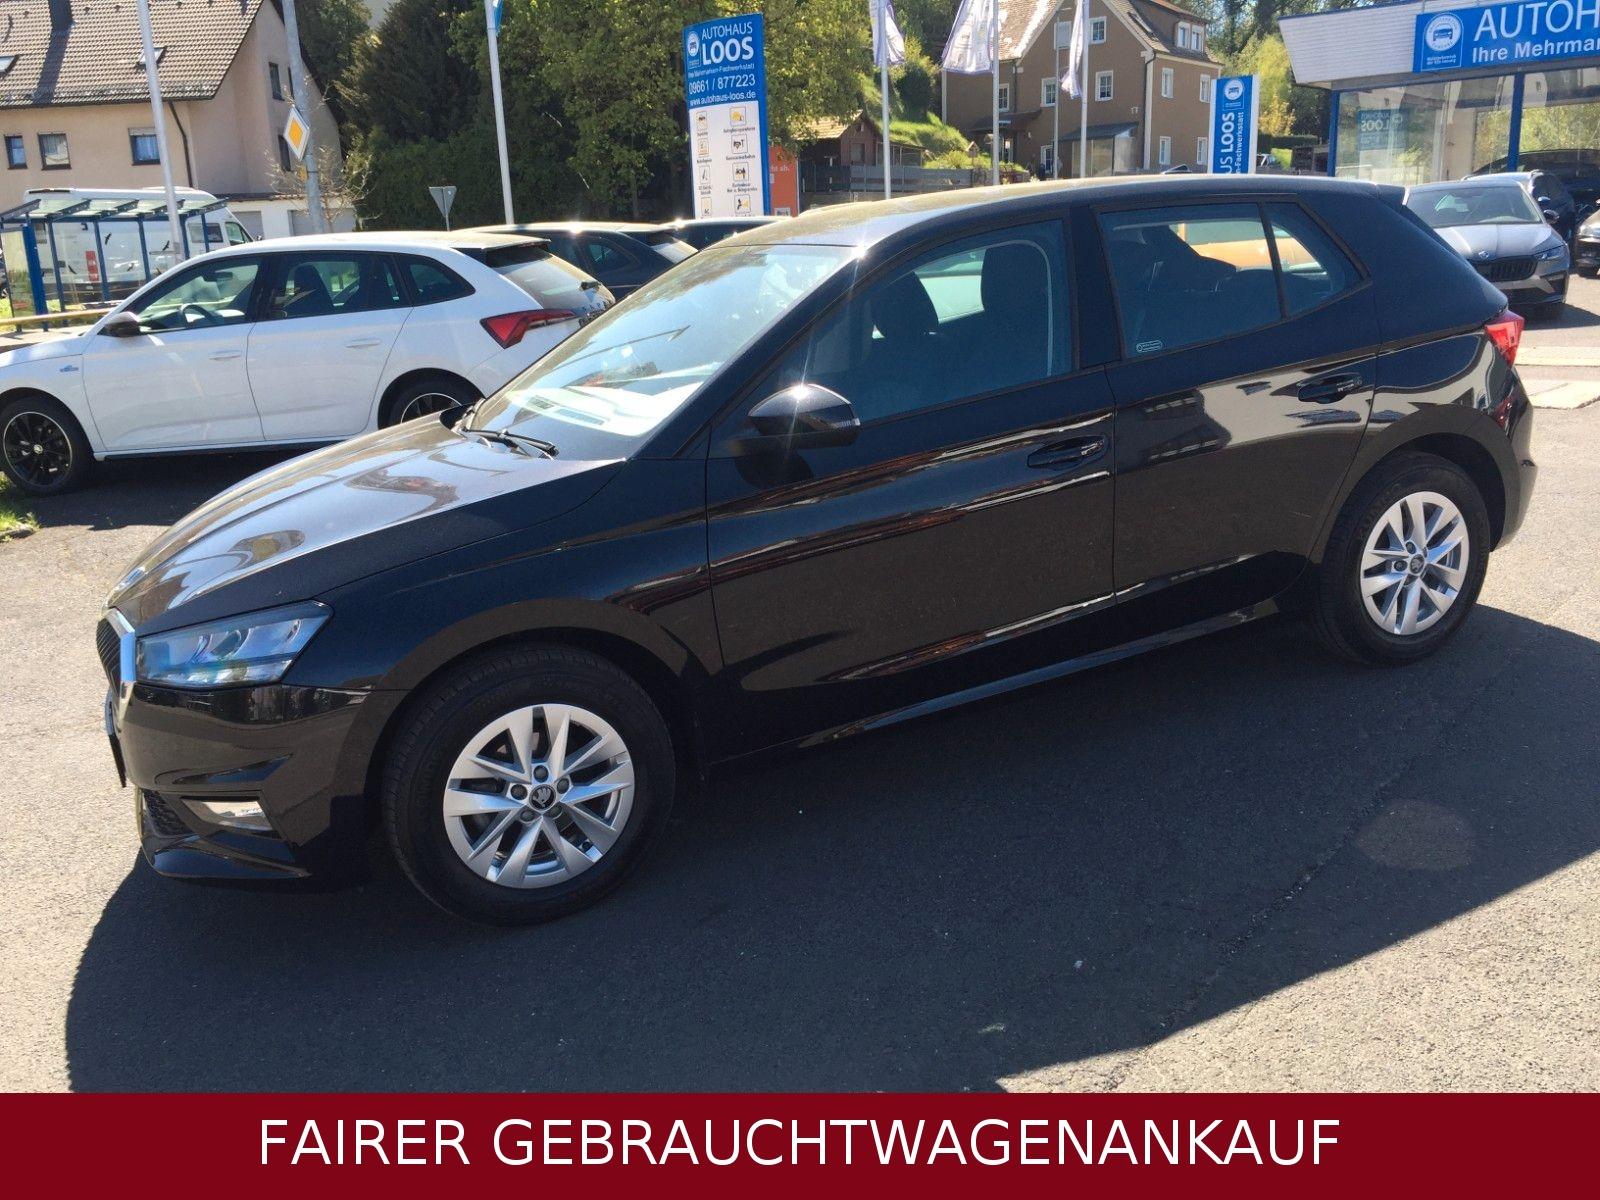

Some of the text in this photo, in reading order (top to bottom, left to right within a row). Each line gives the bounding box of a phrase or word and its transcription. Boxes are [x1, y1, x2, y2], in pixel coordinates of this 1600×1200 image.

[701, 21, 753, 40] AUTOHAUS
[1473, 0, 1600, 41] AUTOH
[702, 36, 754, 65] LOOS
[1472, 47, 1508, 63] Ihre
[688, 79, 709, 95] 09661
[717, 73, 756, 90] 877223
[689, 90, 756, 106] www.autohaus-loos.de
[1221, 112, 1235, 153] LOOS
